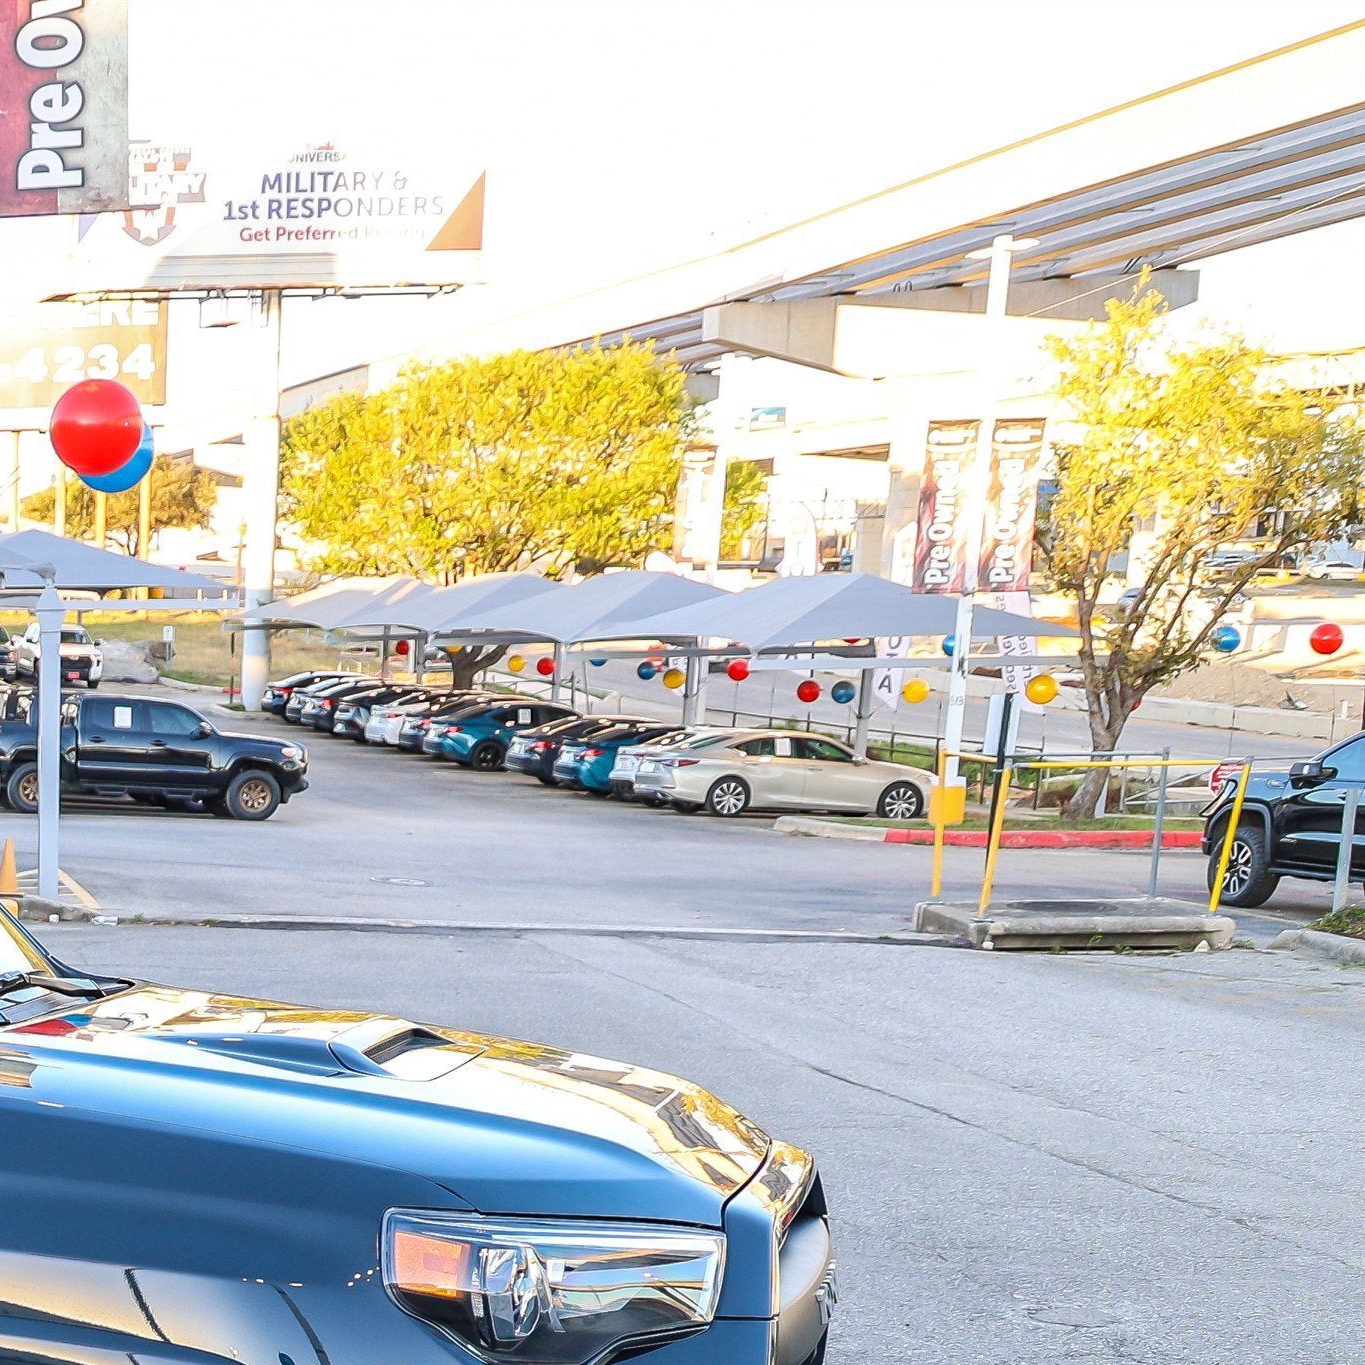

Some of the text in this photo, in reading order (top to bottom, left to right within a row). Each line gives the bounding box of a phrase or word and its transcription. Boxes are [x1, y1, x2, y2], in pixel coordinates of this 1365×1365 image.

[15, 79, 86, 191] Pre
[261, 170, 409, 194] MILITARY &
[222, 195, 445, 221] 1st RESPONDERS
[239, 225, 271, 242] Get
[274, 224, 359, 242] Preferred
